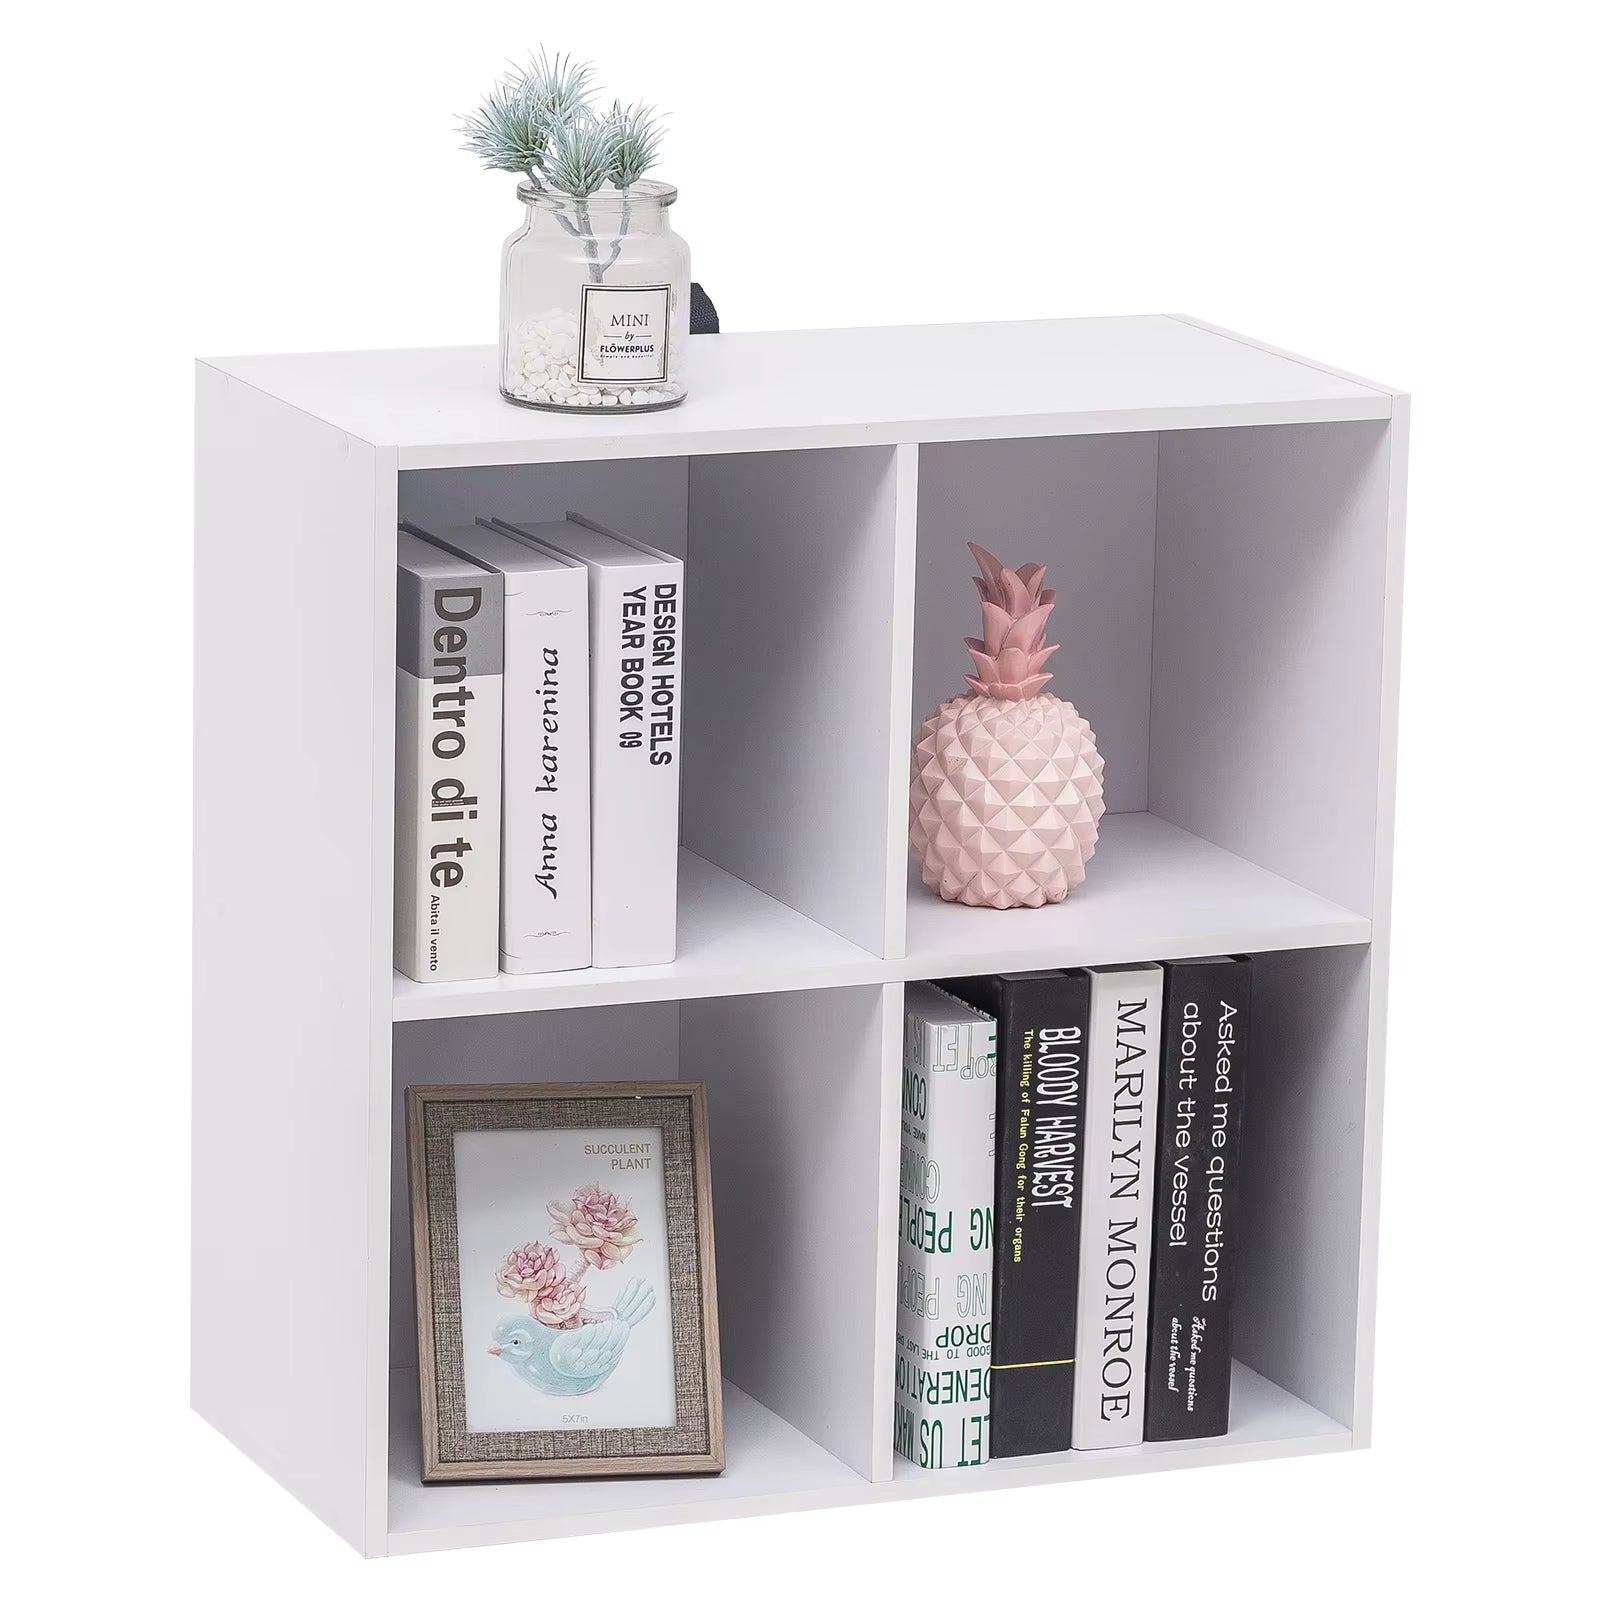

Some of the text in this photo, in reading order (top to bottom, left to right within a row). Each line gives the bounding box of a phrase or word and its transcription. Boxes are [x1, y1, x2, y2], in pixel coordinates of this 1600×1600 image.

[610, 313, 649, 327] MINI
[625, 331, 635, 341] by
[431, 586, 482, 760] Dentro
[618, 585, 648, 749] YEAR BOOK 09
[649, 583, 678, 767] DESIGN HOTELS
[431, 777, 478, 823] di
[534, 646, 559, 900] Anna karenina
[429, 836, 474, 888] te
[429, 894, 440, 971] Abita il vento
[584, 1142, 651, 1156] SUCCULENT
[1012, 1029, 1034, 1263] The killing of Falun Gong for their organs
[1031, 1026, 1082, 1208] BLOODY HARVEST
[1169, 1002, 1202, 1247] about the vessel
[1202, 1000, 1238, 1302] Asked me questions
[611, 1157, 651, 1170] PLANT
[1100, 997, 1149, 1422] MARILYN MONROE
[922, 1348, 939, 1361] THE
[947, 1348, 960, 1359] TO
[1168, 1317, 1182, 1392] about the vessel
[1184, 1316, 1207, 1412] Asked me questions
[919, 1418, 943, 1470] US
